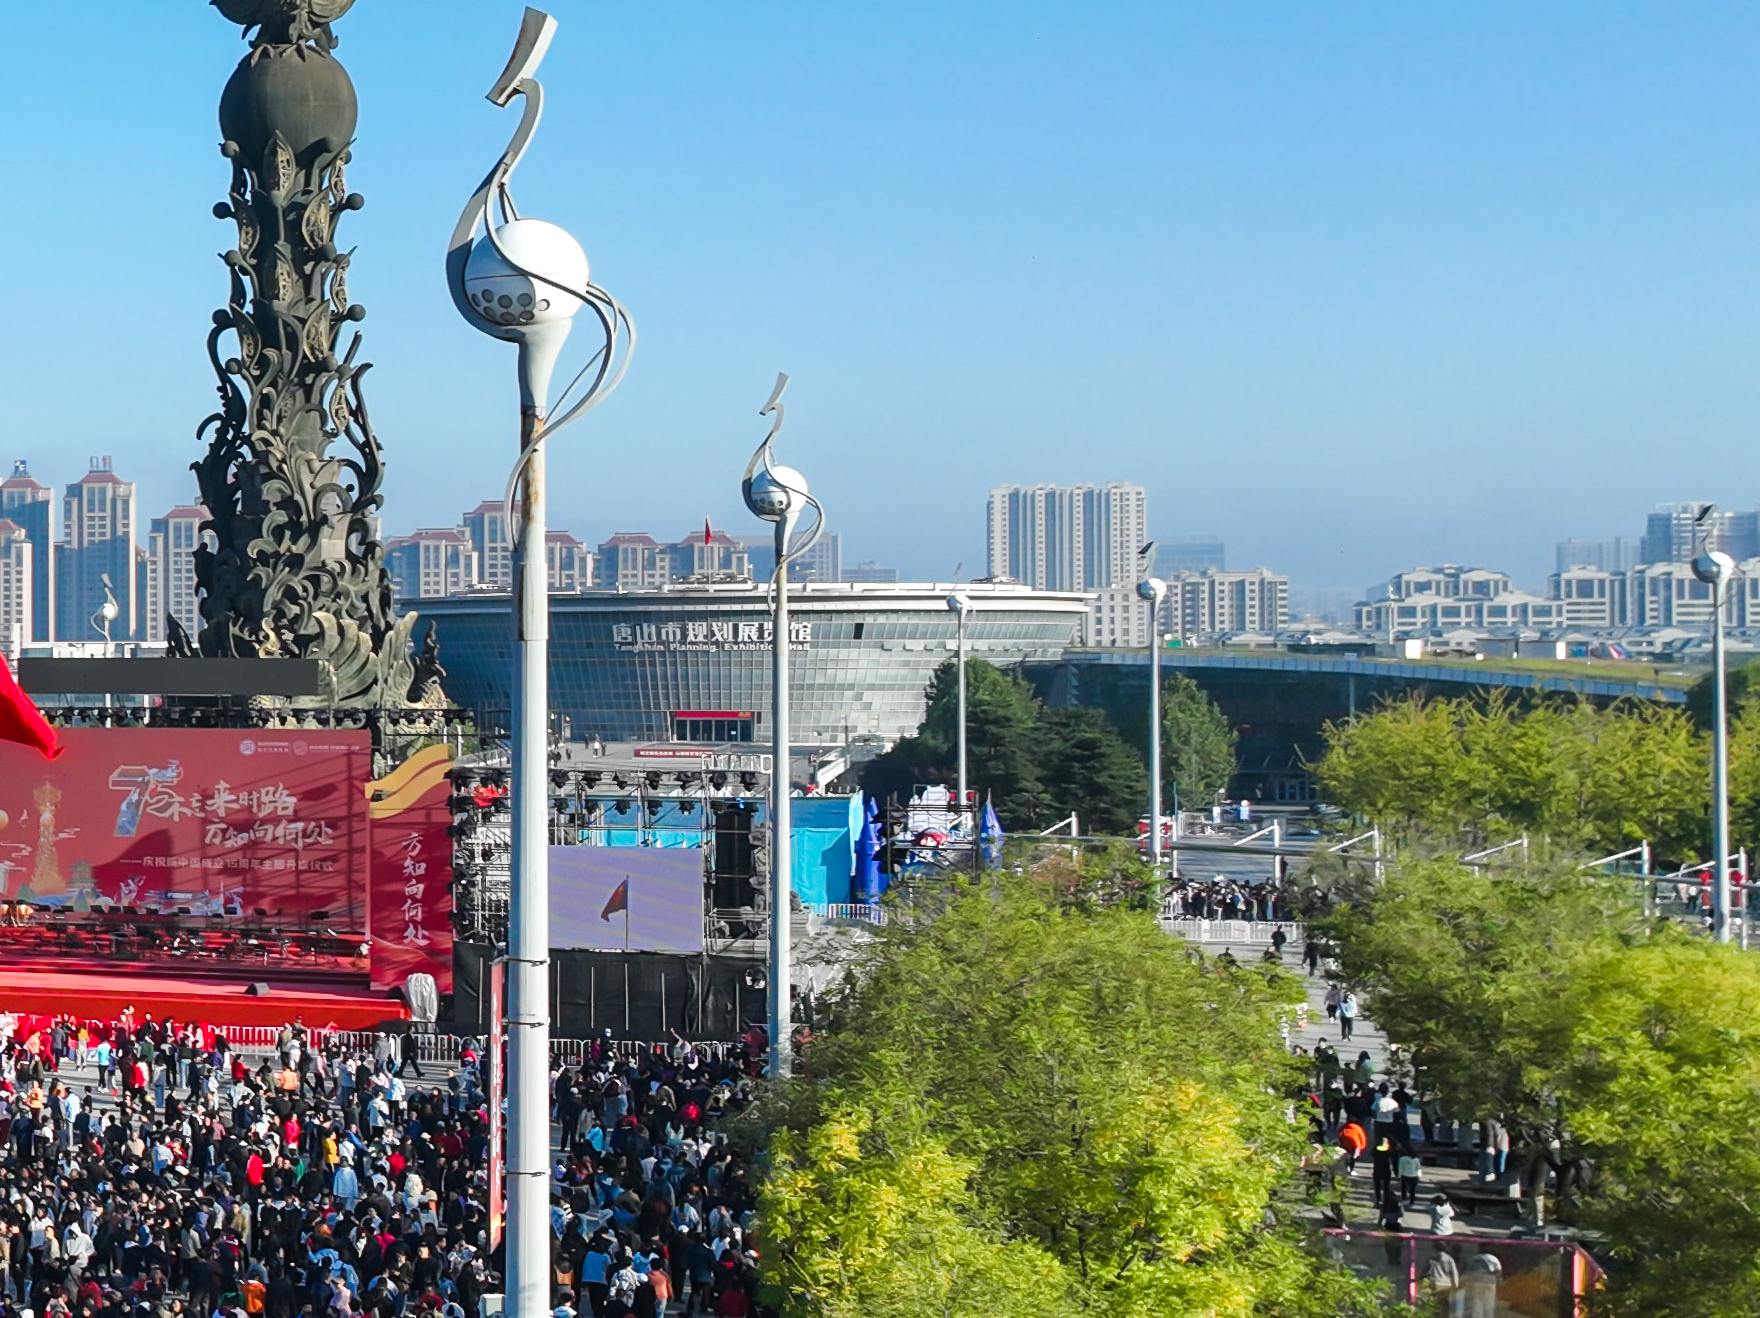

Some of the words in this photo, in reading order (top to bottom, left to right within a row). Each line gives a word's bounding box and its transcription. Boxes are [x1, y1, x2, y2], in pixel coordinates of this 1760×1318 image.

[724, 642, 773, 651] Exhibitio
[204, 819, 334, 851] 方知向何处
[401, 831, 431, 947] 方知向何处
